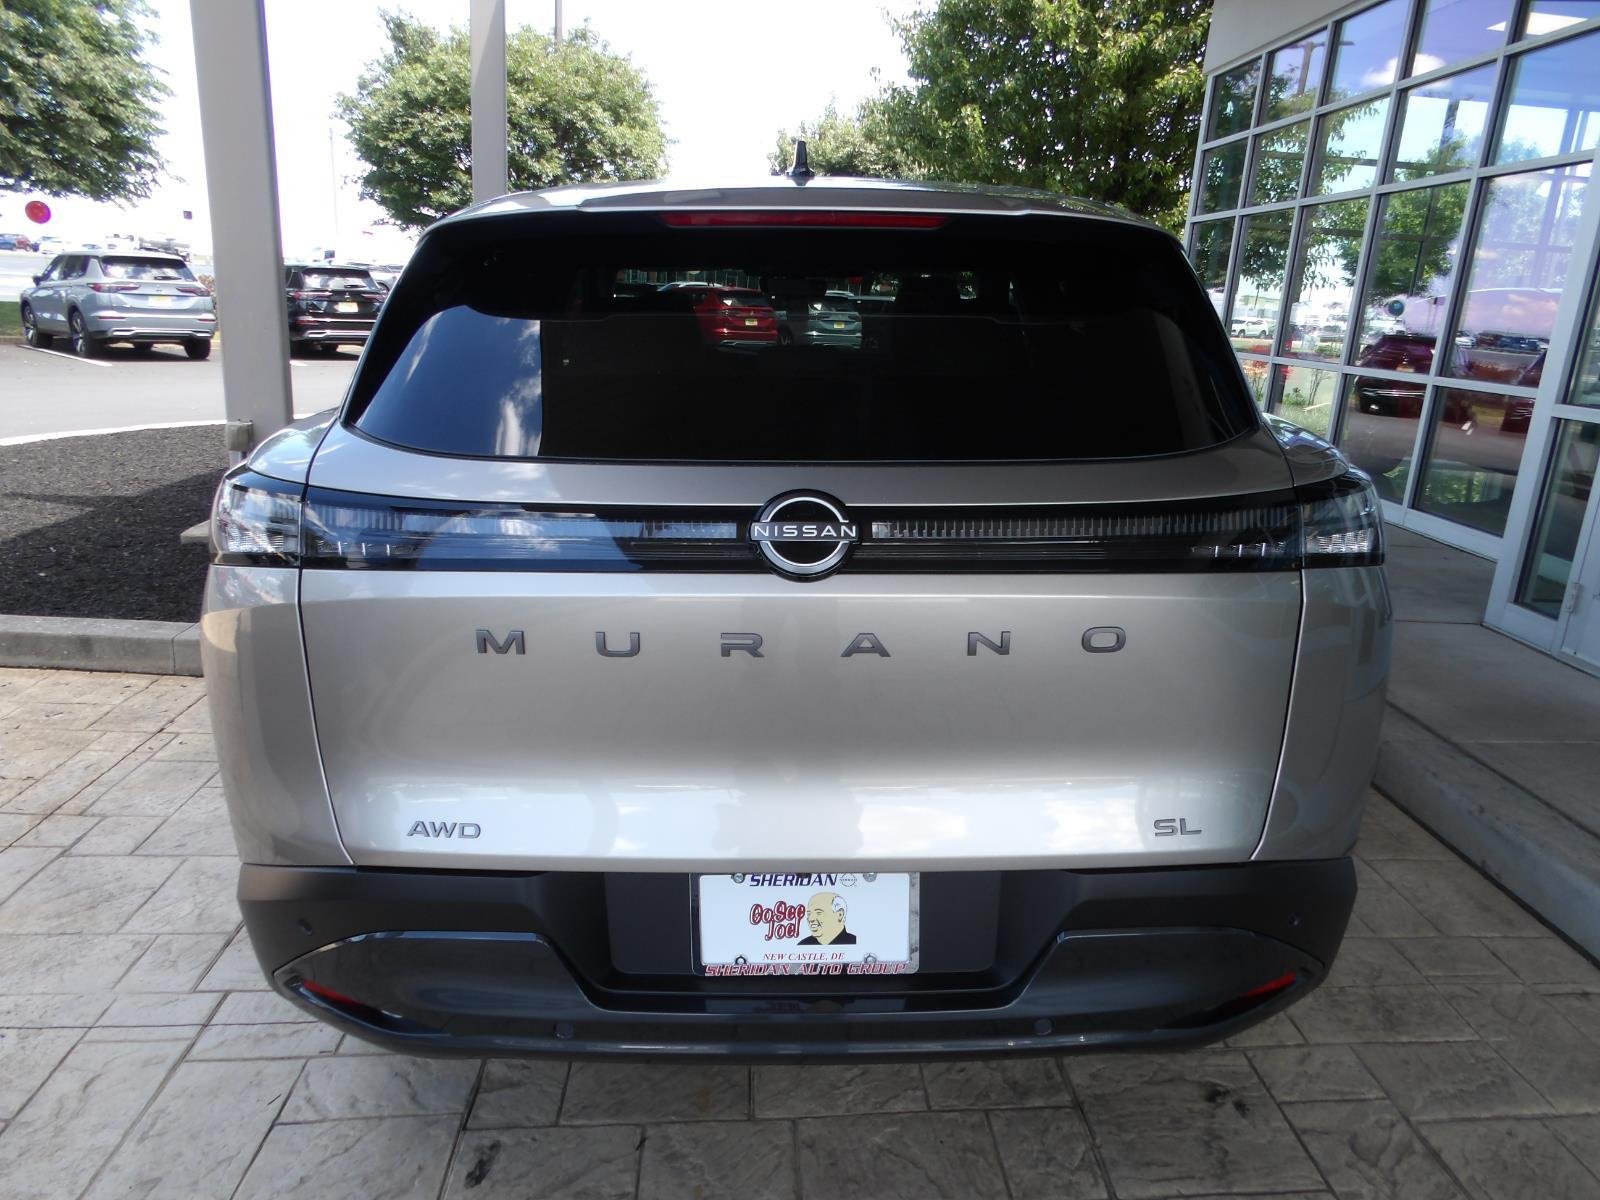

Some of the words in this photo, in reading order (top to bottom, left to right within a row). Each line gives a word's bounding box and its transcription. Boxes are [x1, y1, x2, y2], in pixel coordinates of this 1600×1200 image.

[754, 525, 856, 537] NISSAN
[475, 626, 1127, 659] MURANO
[406, 820, 481, 839] AWD
[1153, 817, 1202, 836] SL
[750, 873, 837, 887] SHERIDAN
[788, 953, 828, 961] CASTLE,
[705, 964, 790, 976] SHERIDAN
[795, 963, 842, 975] AUTO
[847, 963, 906, 974] GROUP
